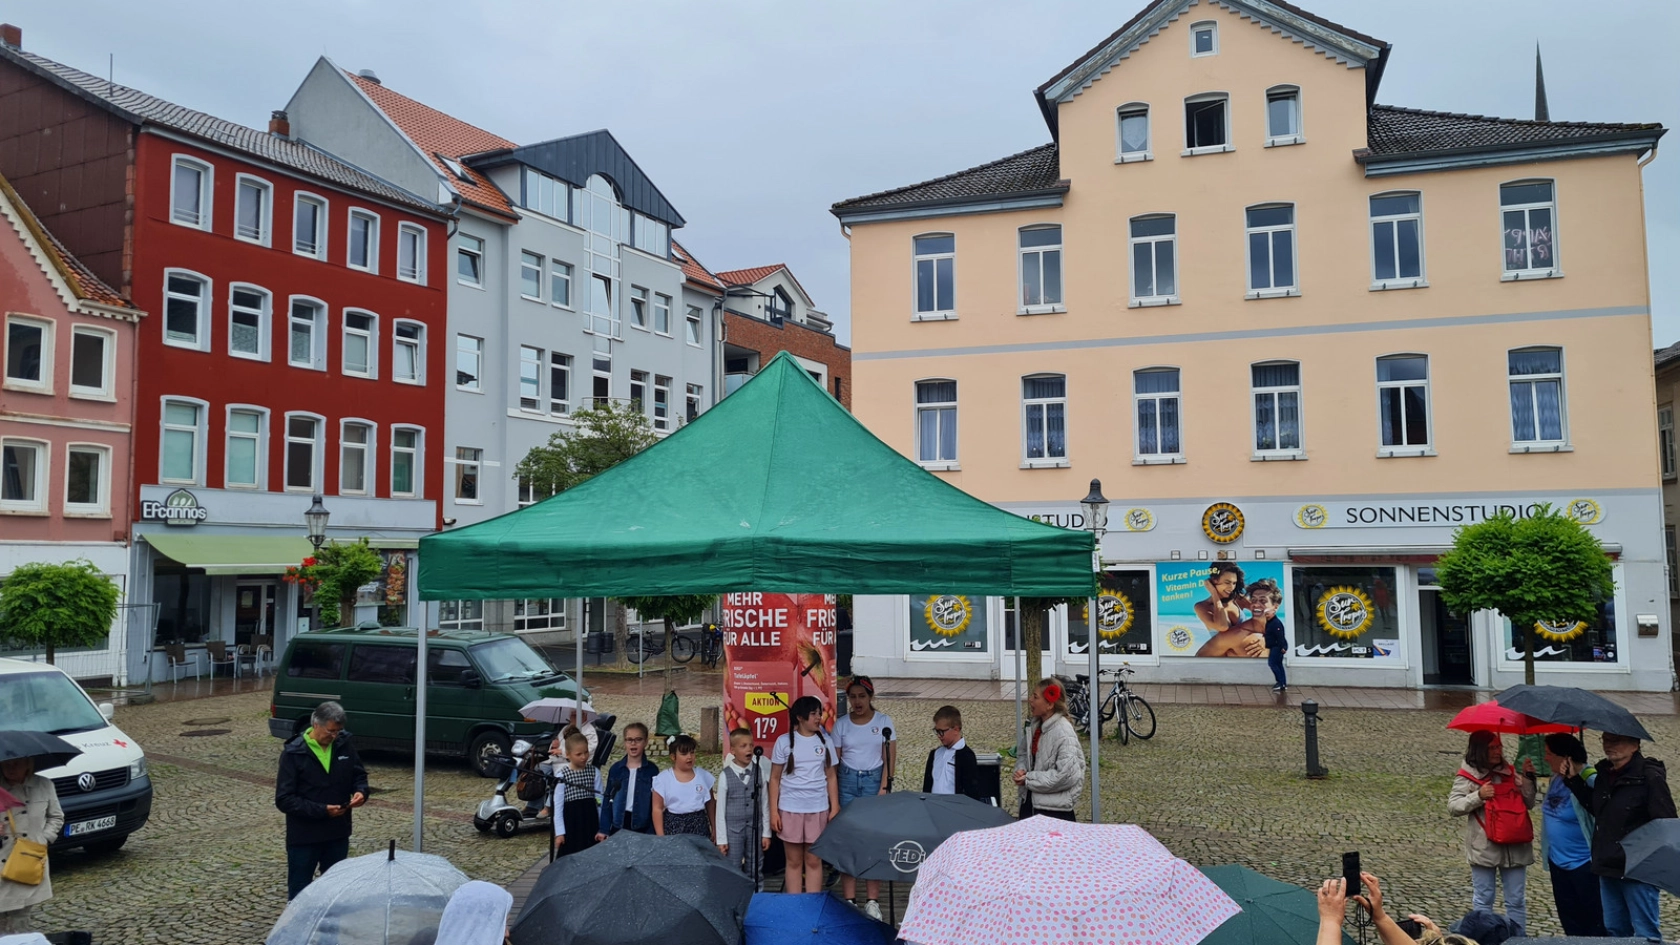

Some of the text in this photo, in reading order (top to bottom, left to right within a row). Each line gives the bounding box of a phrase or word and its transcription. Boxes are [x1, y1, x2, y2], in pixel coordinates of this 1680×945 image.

[1162, 566, 1221, 583] Kurze Pause,
[1165, 581, 1197, 593] Vitamin
[727, 592, 763, 606] MEHR
[1162, 590, 1193, 602] tanken!
[723, 608, 788, 628] RISCHE
[807, 608, 836, 628] FRIS
[740, 631, 781, 646] ALLE
[813, 628, 833, 646] FÜR
[752, 698, 780, 708] AKTION
[71, 824, 81, 834] PE
[86, 821, 96, 832] RK
[889, 848, 926, 864] TEDi
